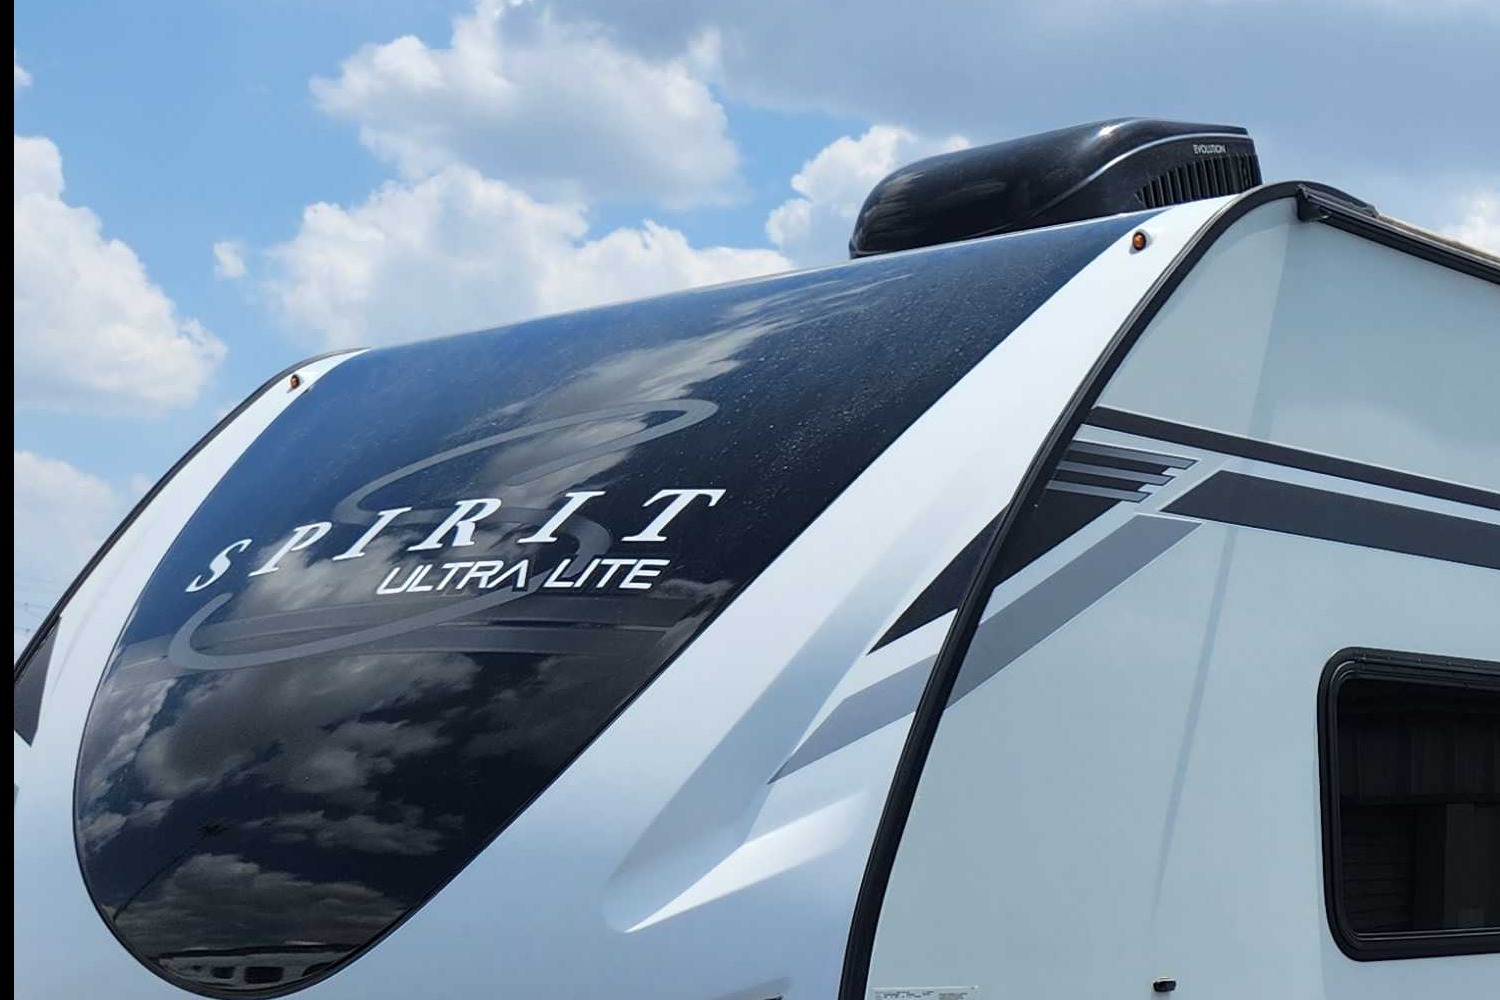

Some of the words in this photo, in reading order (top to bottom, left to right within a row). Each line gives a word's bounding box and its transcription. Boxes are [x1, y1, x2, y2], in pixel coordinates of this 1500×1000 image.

[1192, 144, 1227, 154] EVOLUTION
[184, 488, 726, 593] SPIRIT
[376, 558, 528, 595] ULTRA
[543, 558, 671, 590] LITE
